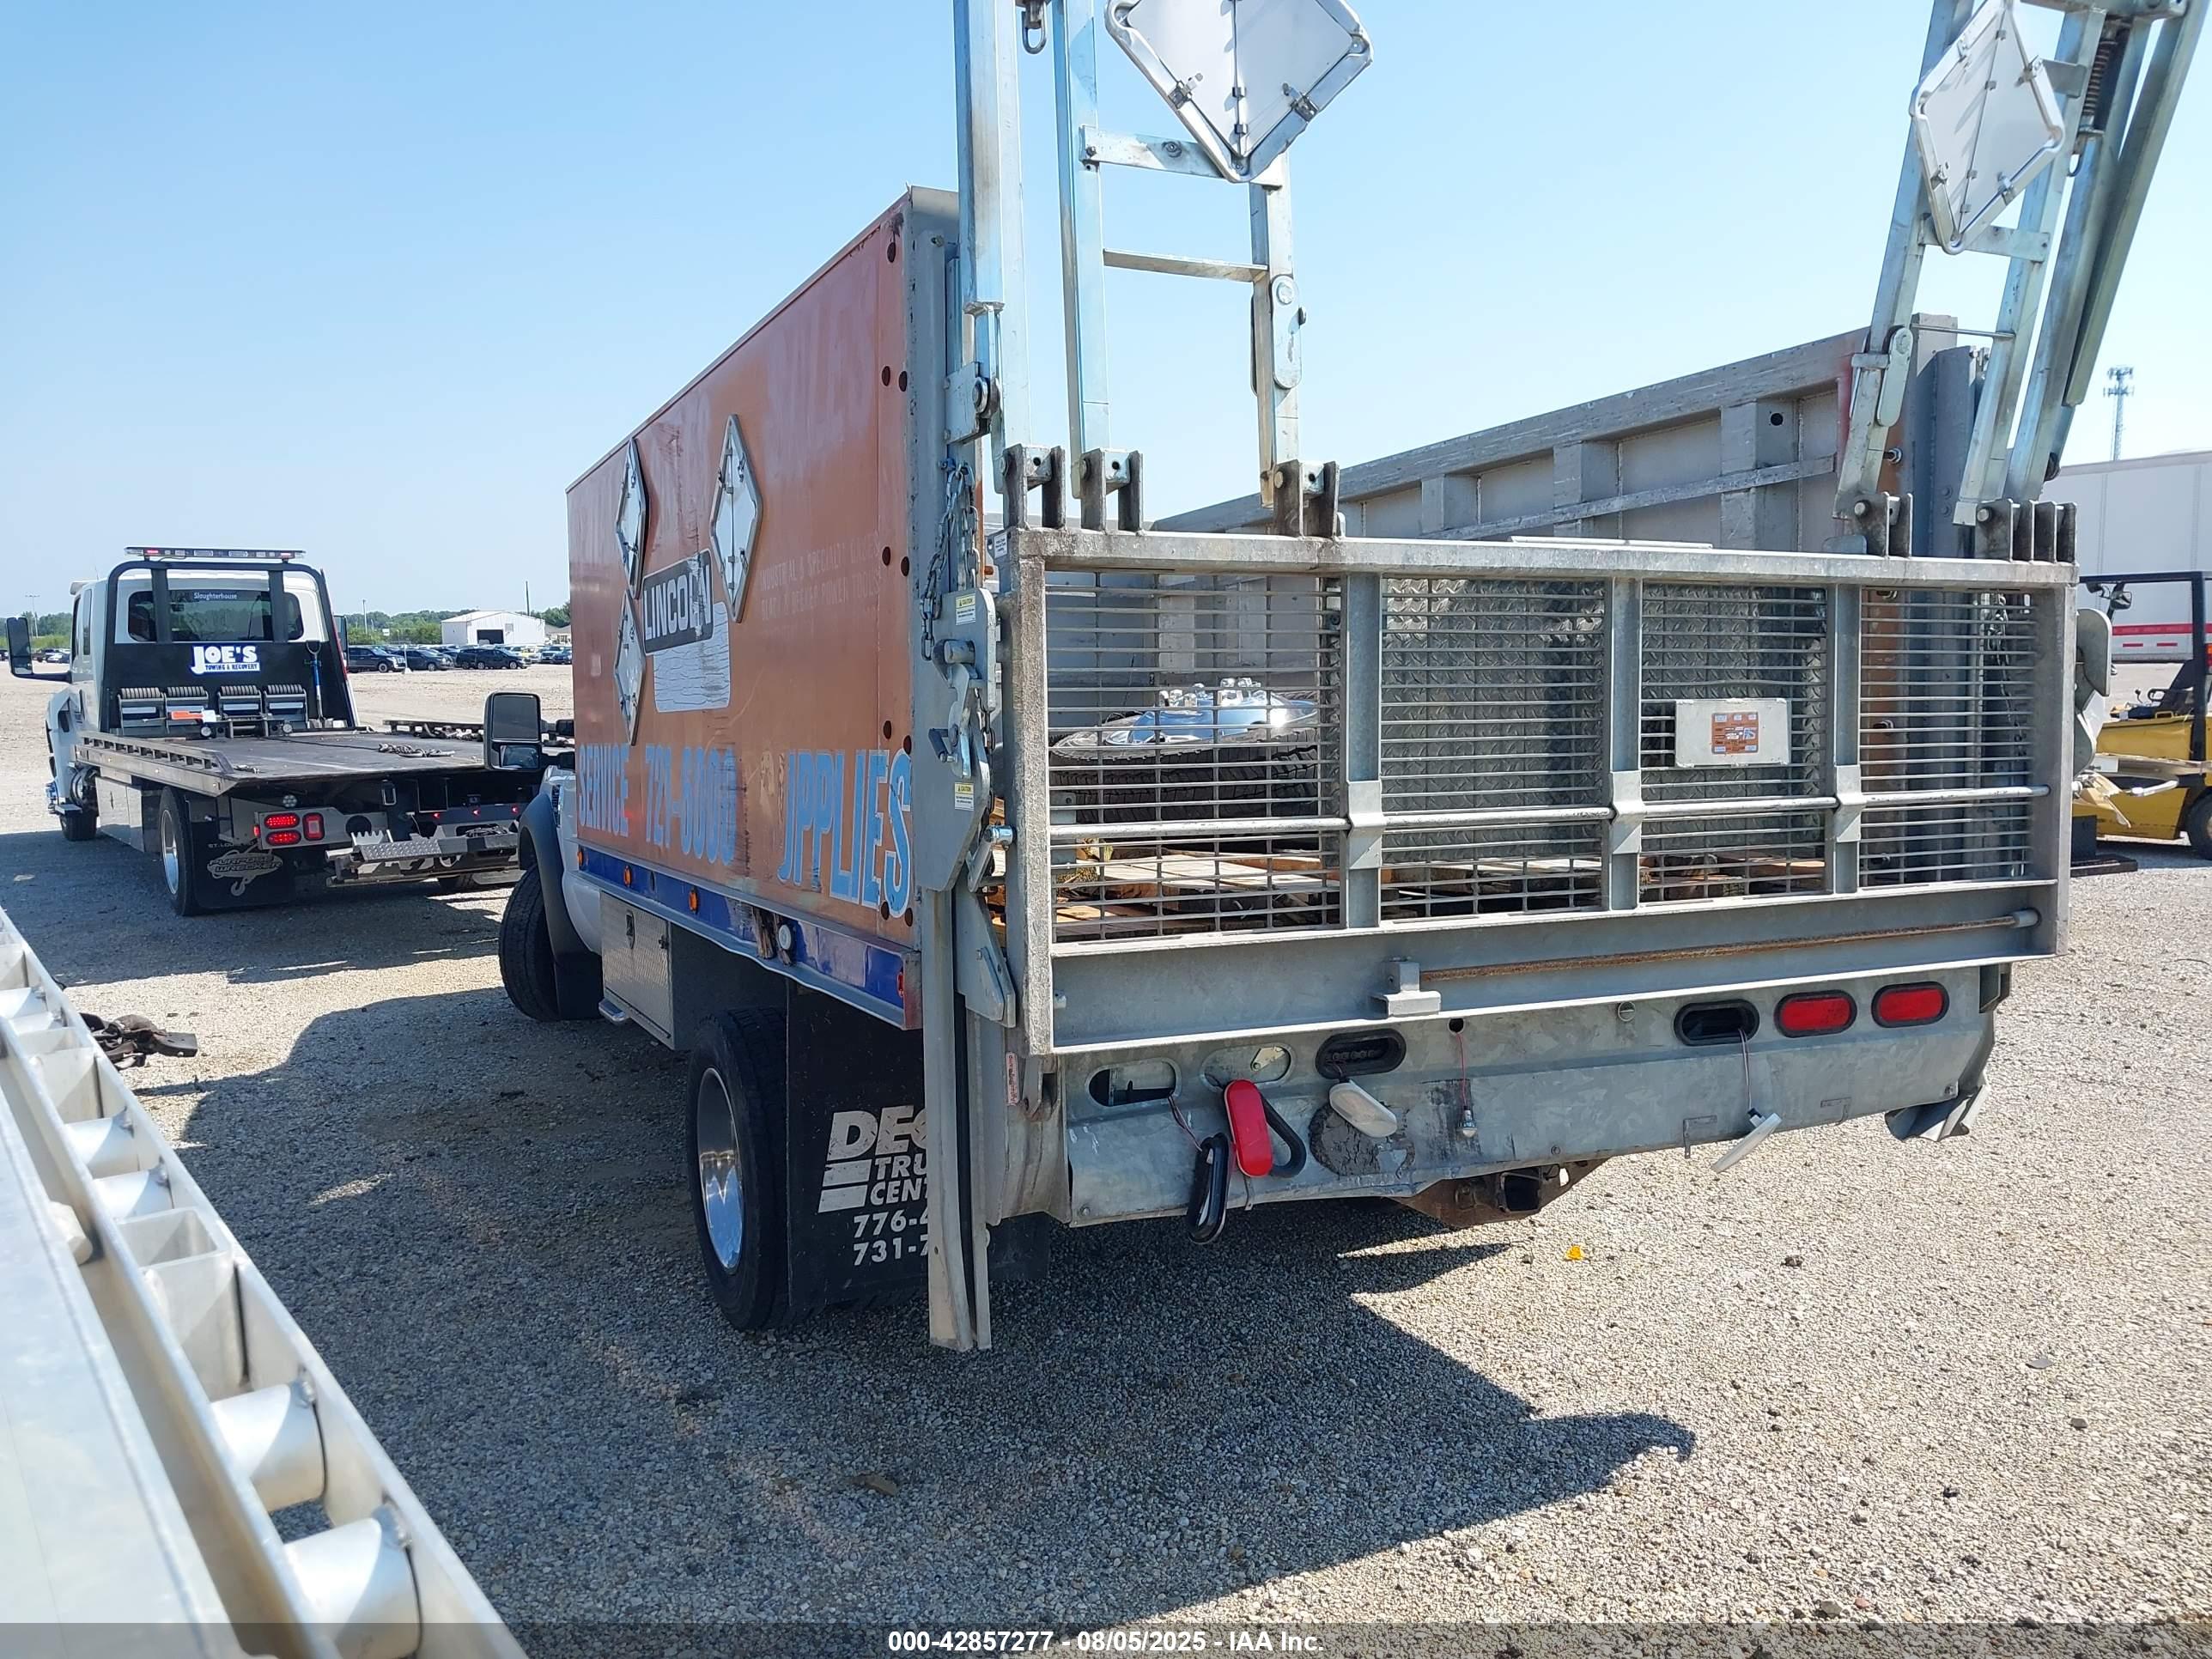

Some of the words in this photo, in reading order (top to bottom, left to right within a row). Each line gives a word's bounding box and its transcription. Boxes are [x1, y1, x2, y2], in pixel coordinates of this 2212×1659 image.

[643, 564, 712, 641] LINCOLN
[191, 645, 258, 675] JOE'S
[578, 742, 630, 838] SERVICE
